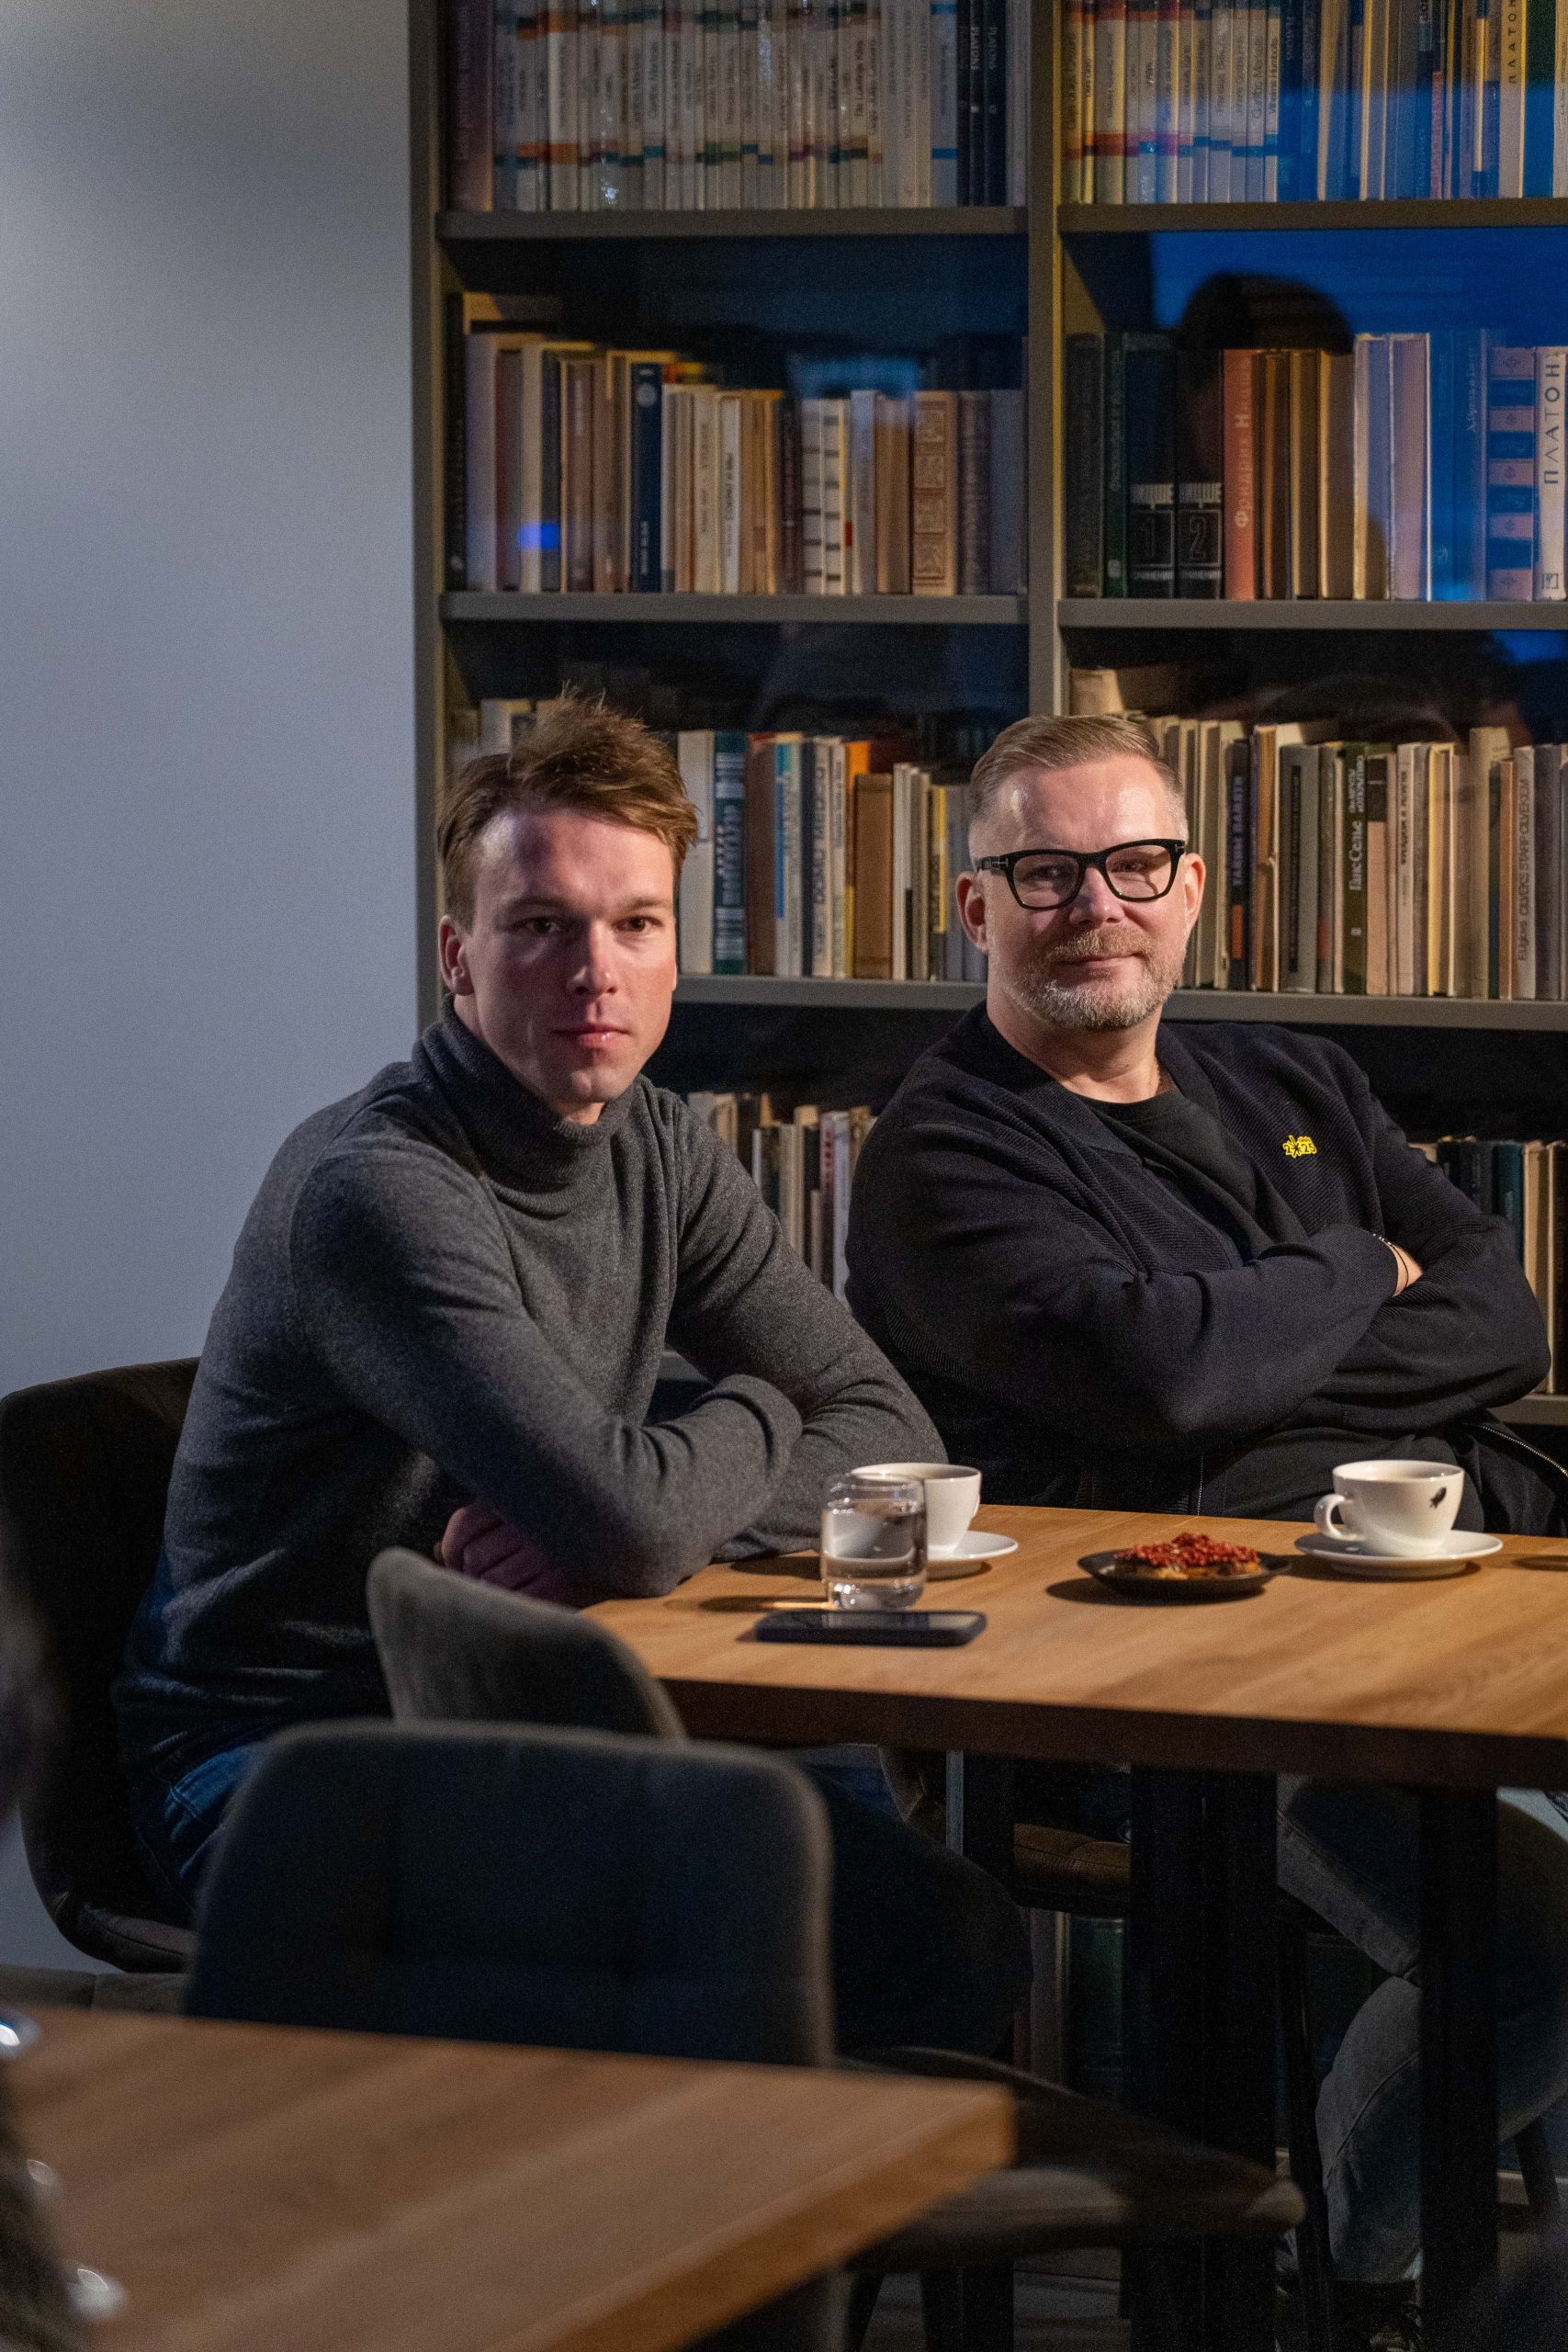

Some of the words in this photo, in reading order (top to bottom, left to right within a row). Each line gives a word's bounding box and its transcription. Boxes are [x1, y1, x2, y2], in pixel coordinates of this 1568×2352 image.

[970, 26, 980, 70] PLATONS
[988, 26, 998, 70] PLATONS
[1544, 364, 1560, 484] ПЛАТОН
[1235, 437, 1251, 528] Фридрих
